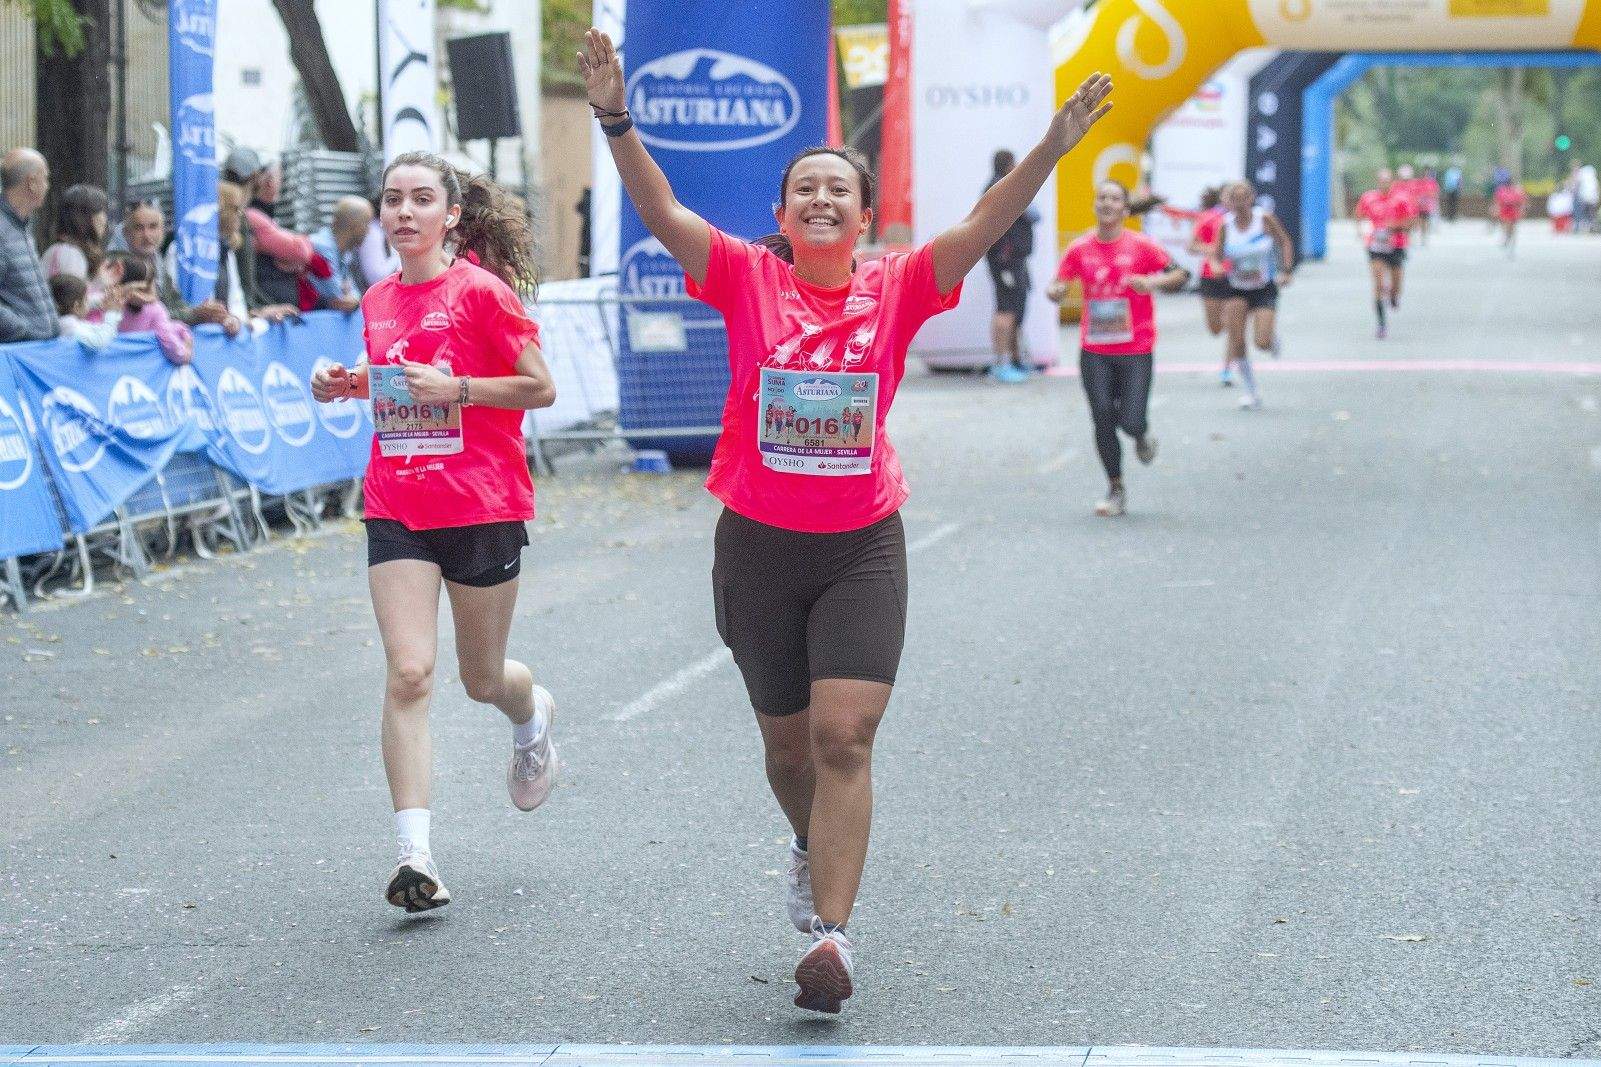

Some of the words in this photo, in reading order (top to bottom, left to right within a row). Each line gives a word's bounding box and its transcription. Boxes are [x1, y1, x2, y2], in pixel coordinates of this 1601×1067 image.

[925, 83, 1030, 108] OYSHO
[633, 87, 788, 126] ASTURIANA
[796, 387, 838, 396] ASTURIANA
[398, 405, 431, 419] 016
[795, 417, 839, 435] 016
[804, 438, 825, 447] 6581
[773, 445, 797, 454] CARRERA
[769, 456, 804, 468] OYSHO
[827, 462, 859, 470] Santander
